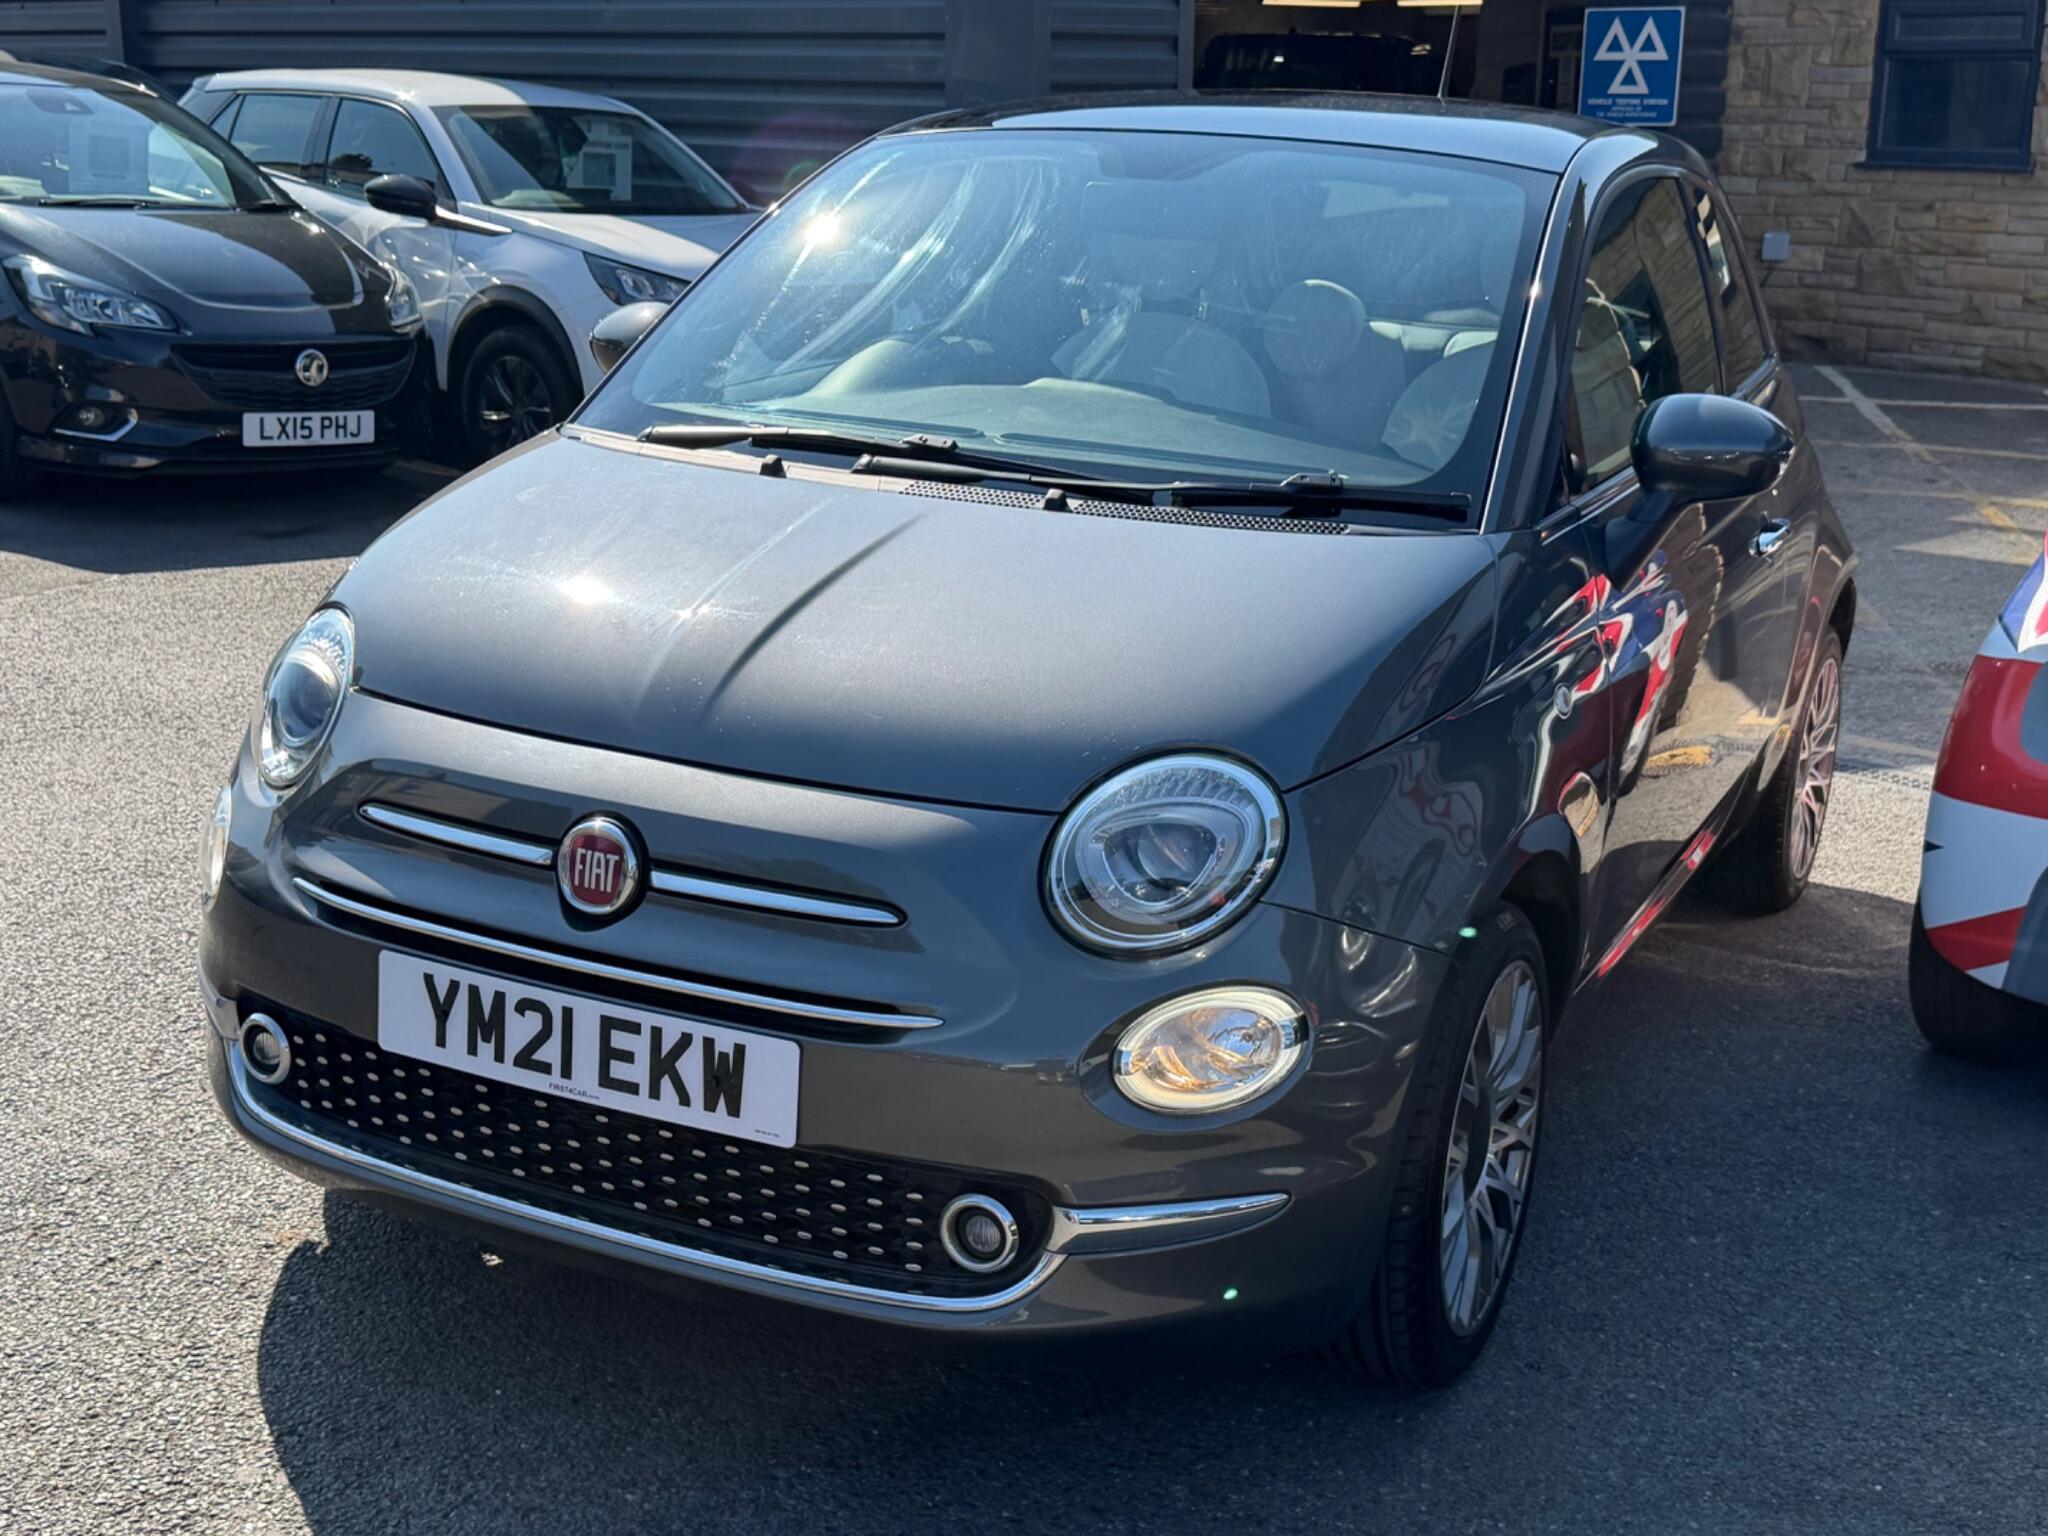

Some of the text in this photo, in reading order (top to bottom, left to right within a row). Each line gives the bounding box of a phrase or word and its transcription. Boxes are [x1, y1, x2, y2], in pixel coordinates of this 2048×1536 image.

[260, 415, 361, 441] LX15 PHJ
[574, 847, 620, 893] FIAT
[423, 972, 747, 1119] YM21 EKW
